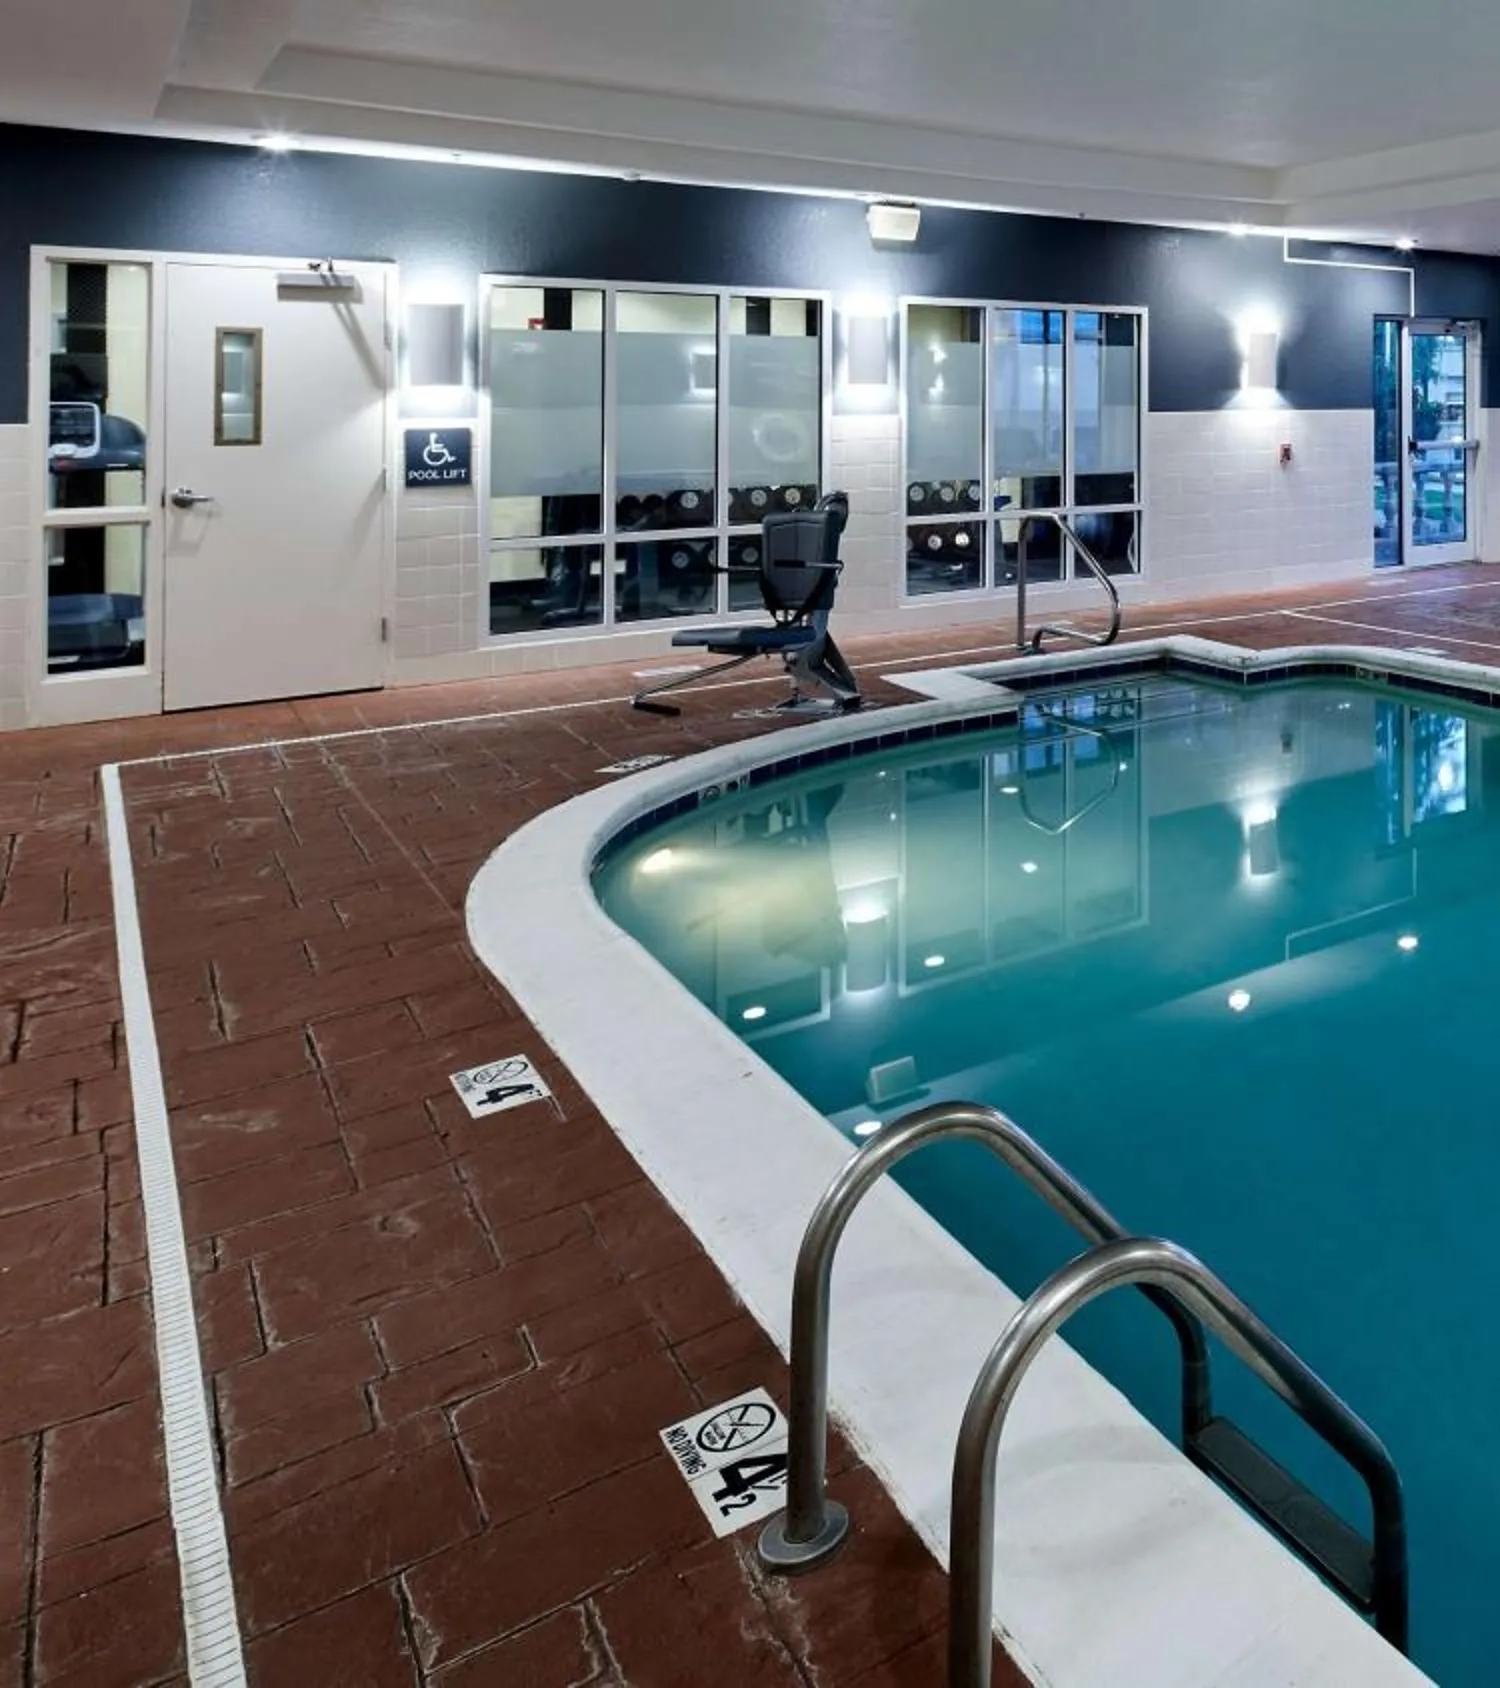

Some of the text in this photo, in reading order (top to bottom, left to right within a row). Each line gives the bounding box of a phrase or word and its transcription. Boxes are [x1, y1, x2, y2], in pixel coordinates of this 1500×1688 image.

[408, 469, 466, 480] POOL LIFT
[476, 1083, 535, 1106] 4
[664, 1426, 707, 1475] NO DIVING
